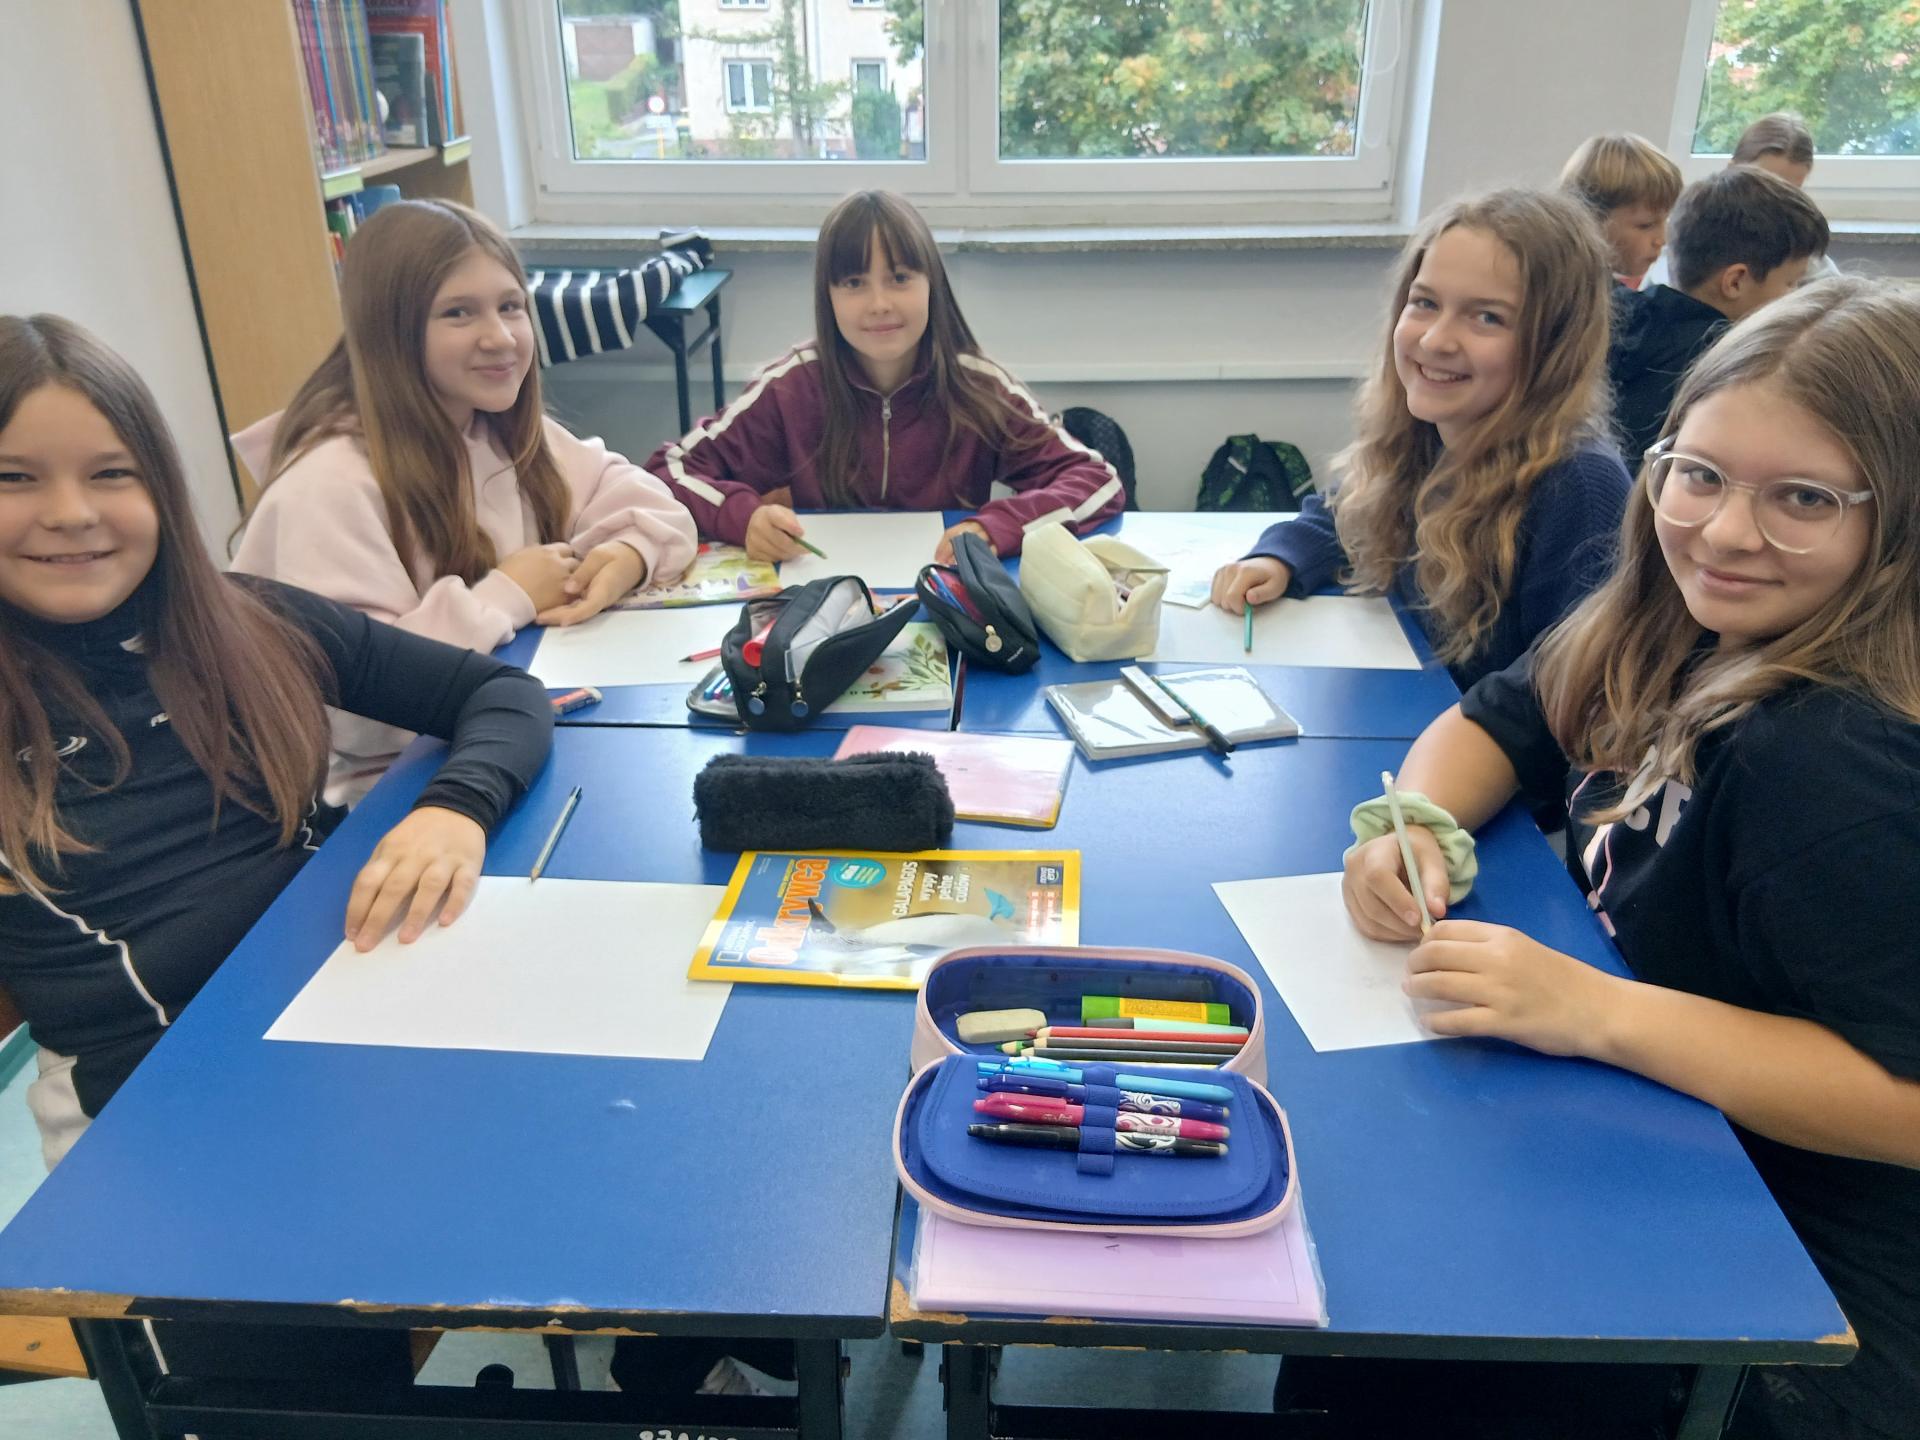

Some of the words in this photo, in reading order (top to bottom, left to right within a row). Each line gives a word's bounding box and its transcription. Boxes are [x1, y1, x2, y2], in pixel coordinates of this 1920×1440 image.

[892, 861, 919, 915] GALAPAGOS
[919, 872, 937, 902] wyspy
[955, 873, 970, 903] cudów
[746, 859, 829, 965] Odkrywca
